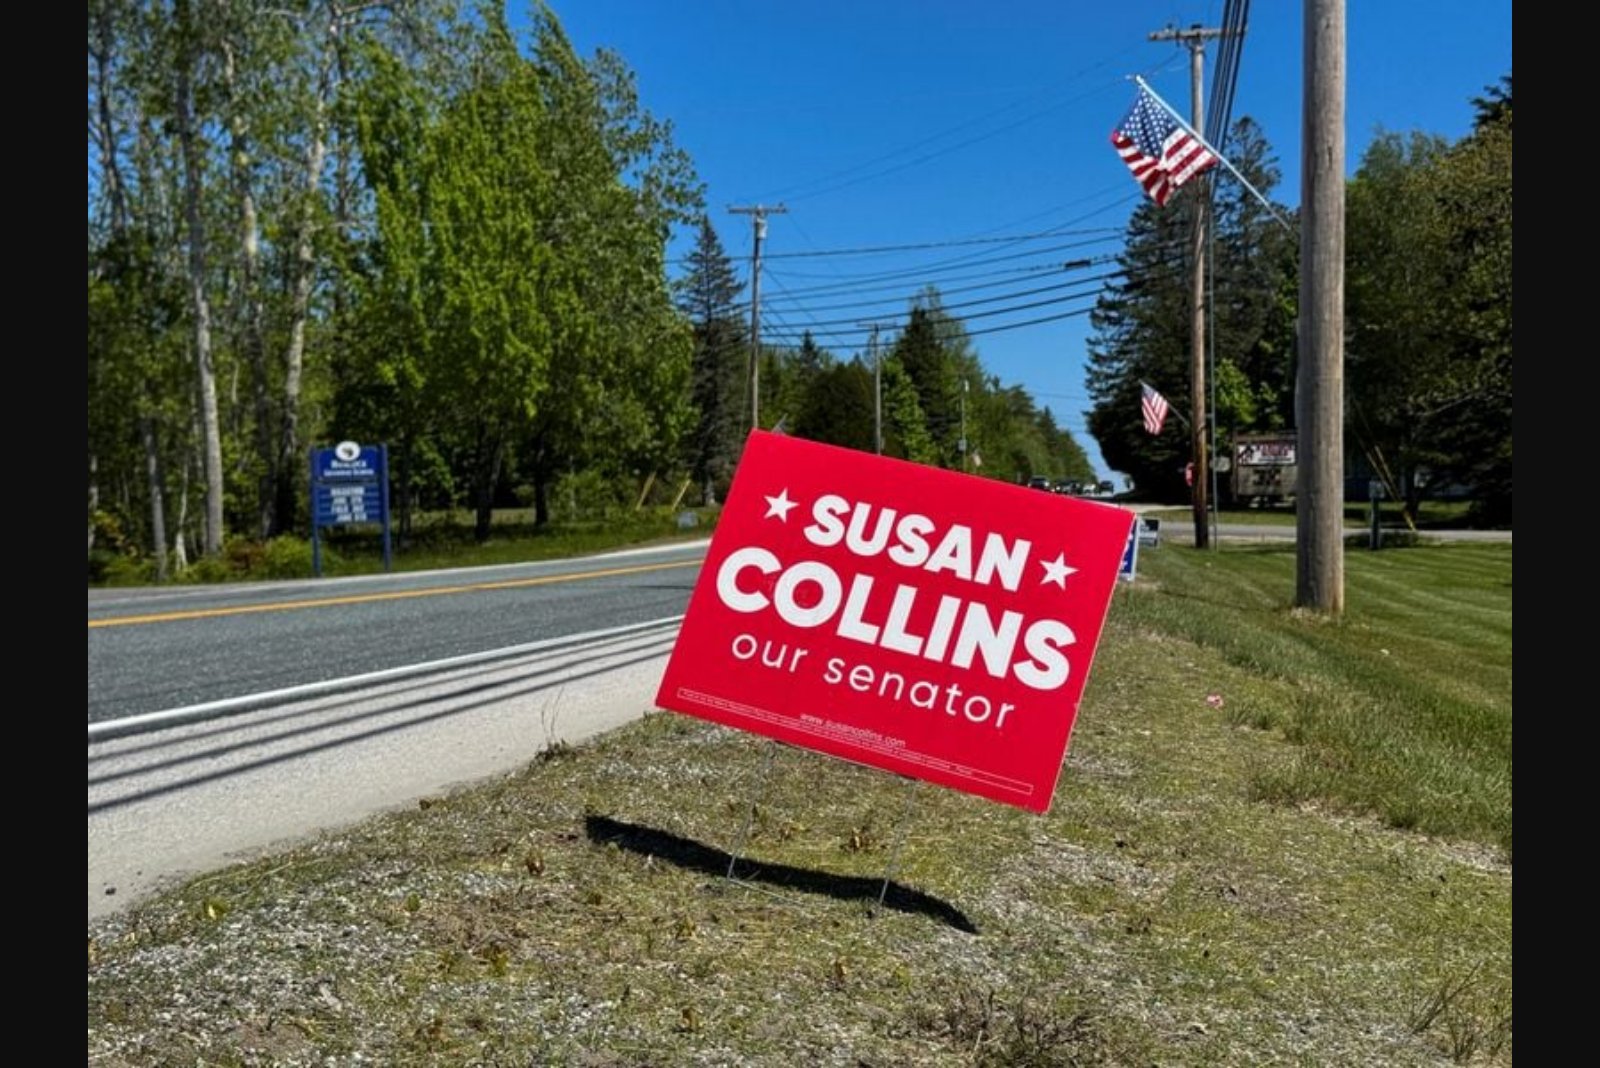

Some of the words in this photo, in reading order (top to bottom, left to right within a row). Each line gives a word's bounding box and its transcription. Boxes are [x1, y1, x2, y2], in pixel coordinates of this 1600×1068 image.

[803, 494, 1032, 592] SUSAN
[716, 547, 1076, 690] COLLINS
[732, 634, 808, 672] our
[823, 657, 1015, 728] senator
